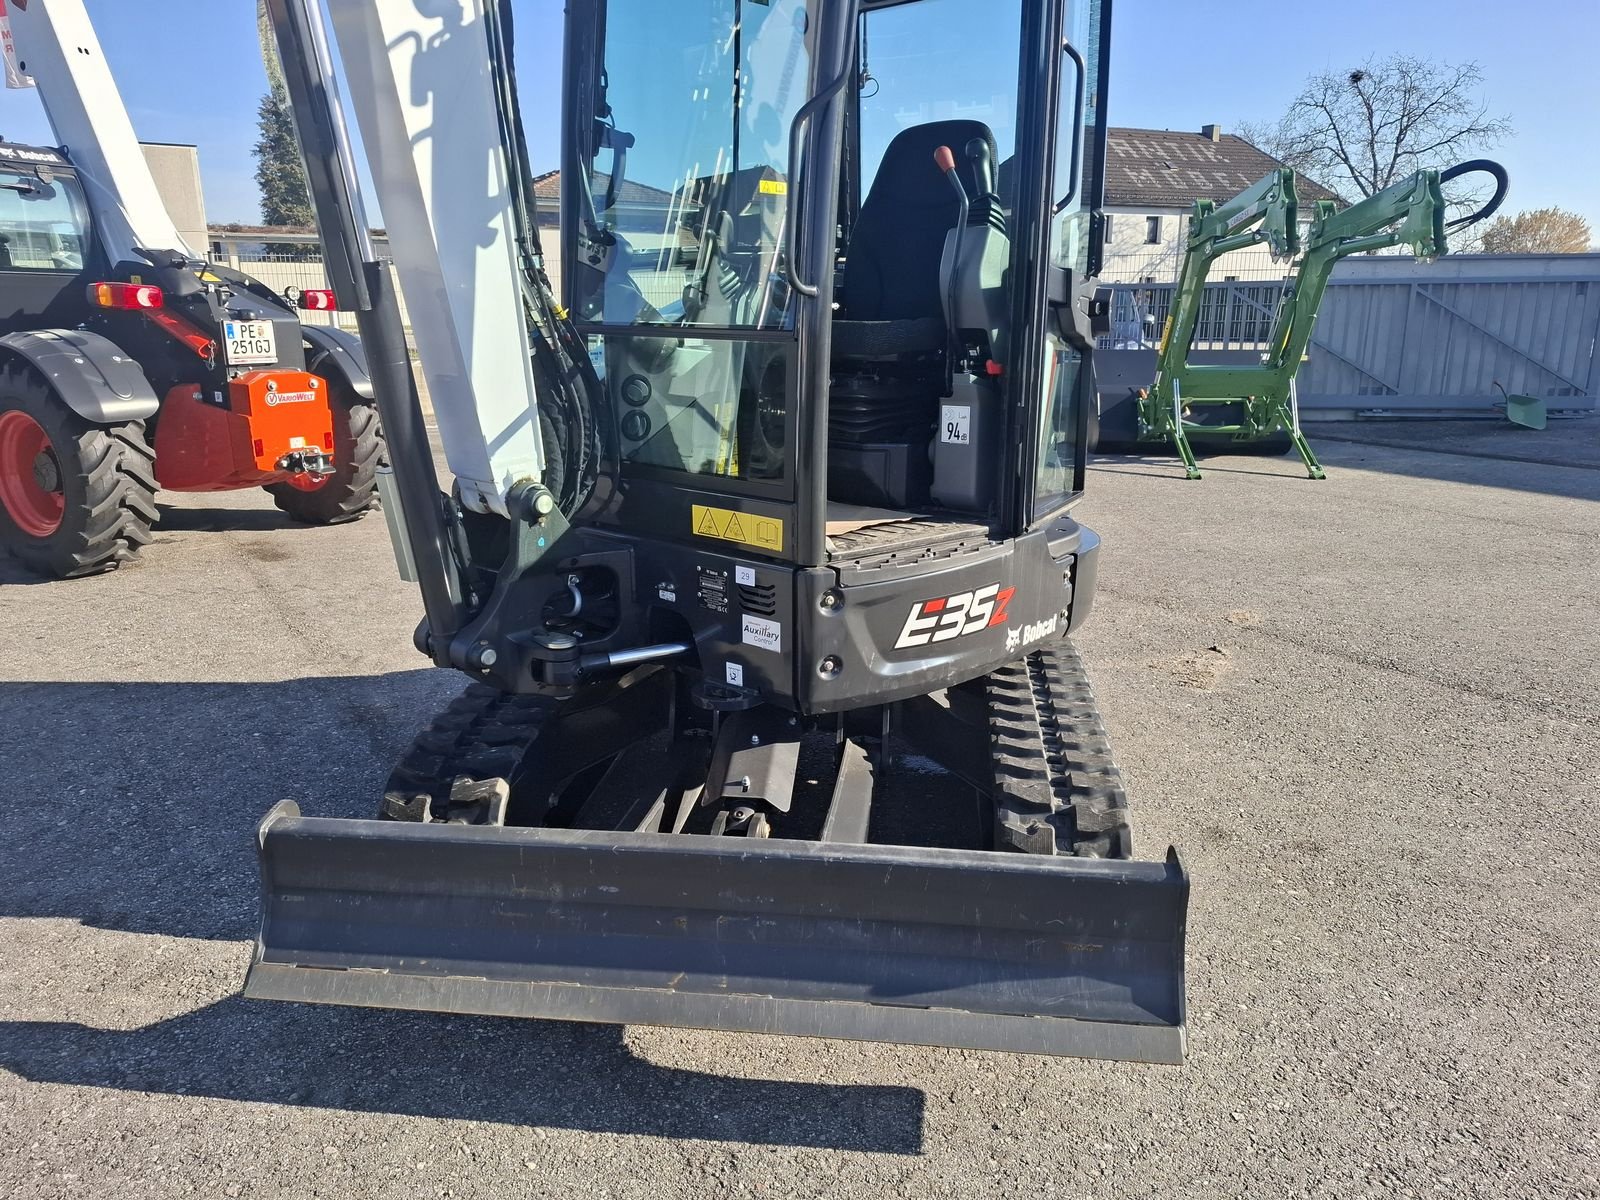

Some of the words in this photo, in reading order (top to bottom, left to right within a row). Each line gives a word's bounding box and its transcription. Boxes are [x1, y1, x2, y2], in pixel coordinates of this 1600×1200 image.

[16, 149, 59, 162] Bobcat
[240, 324, 256, 339] PE
[231, 339, 271, 355] 251GJ
[947, 421, 960, 441] 94
[740, 571, 750, 581] 29
[1022, 613, 1058, 646] Bobcat
[753, 635, 773, 646] Control
